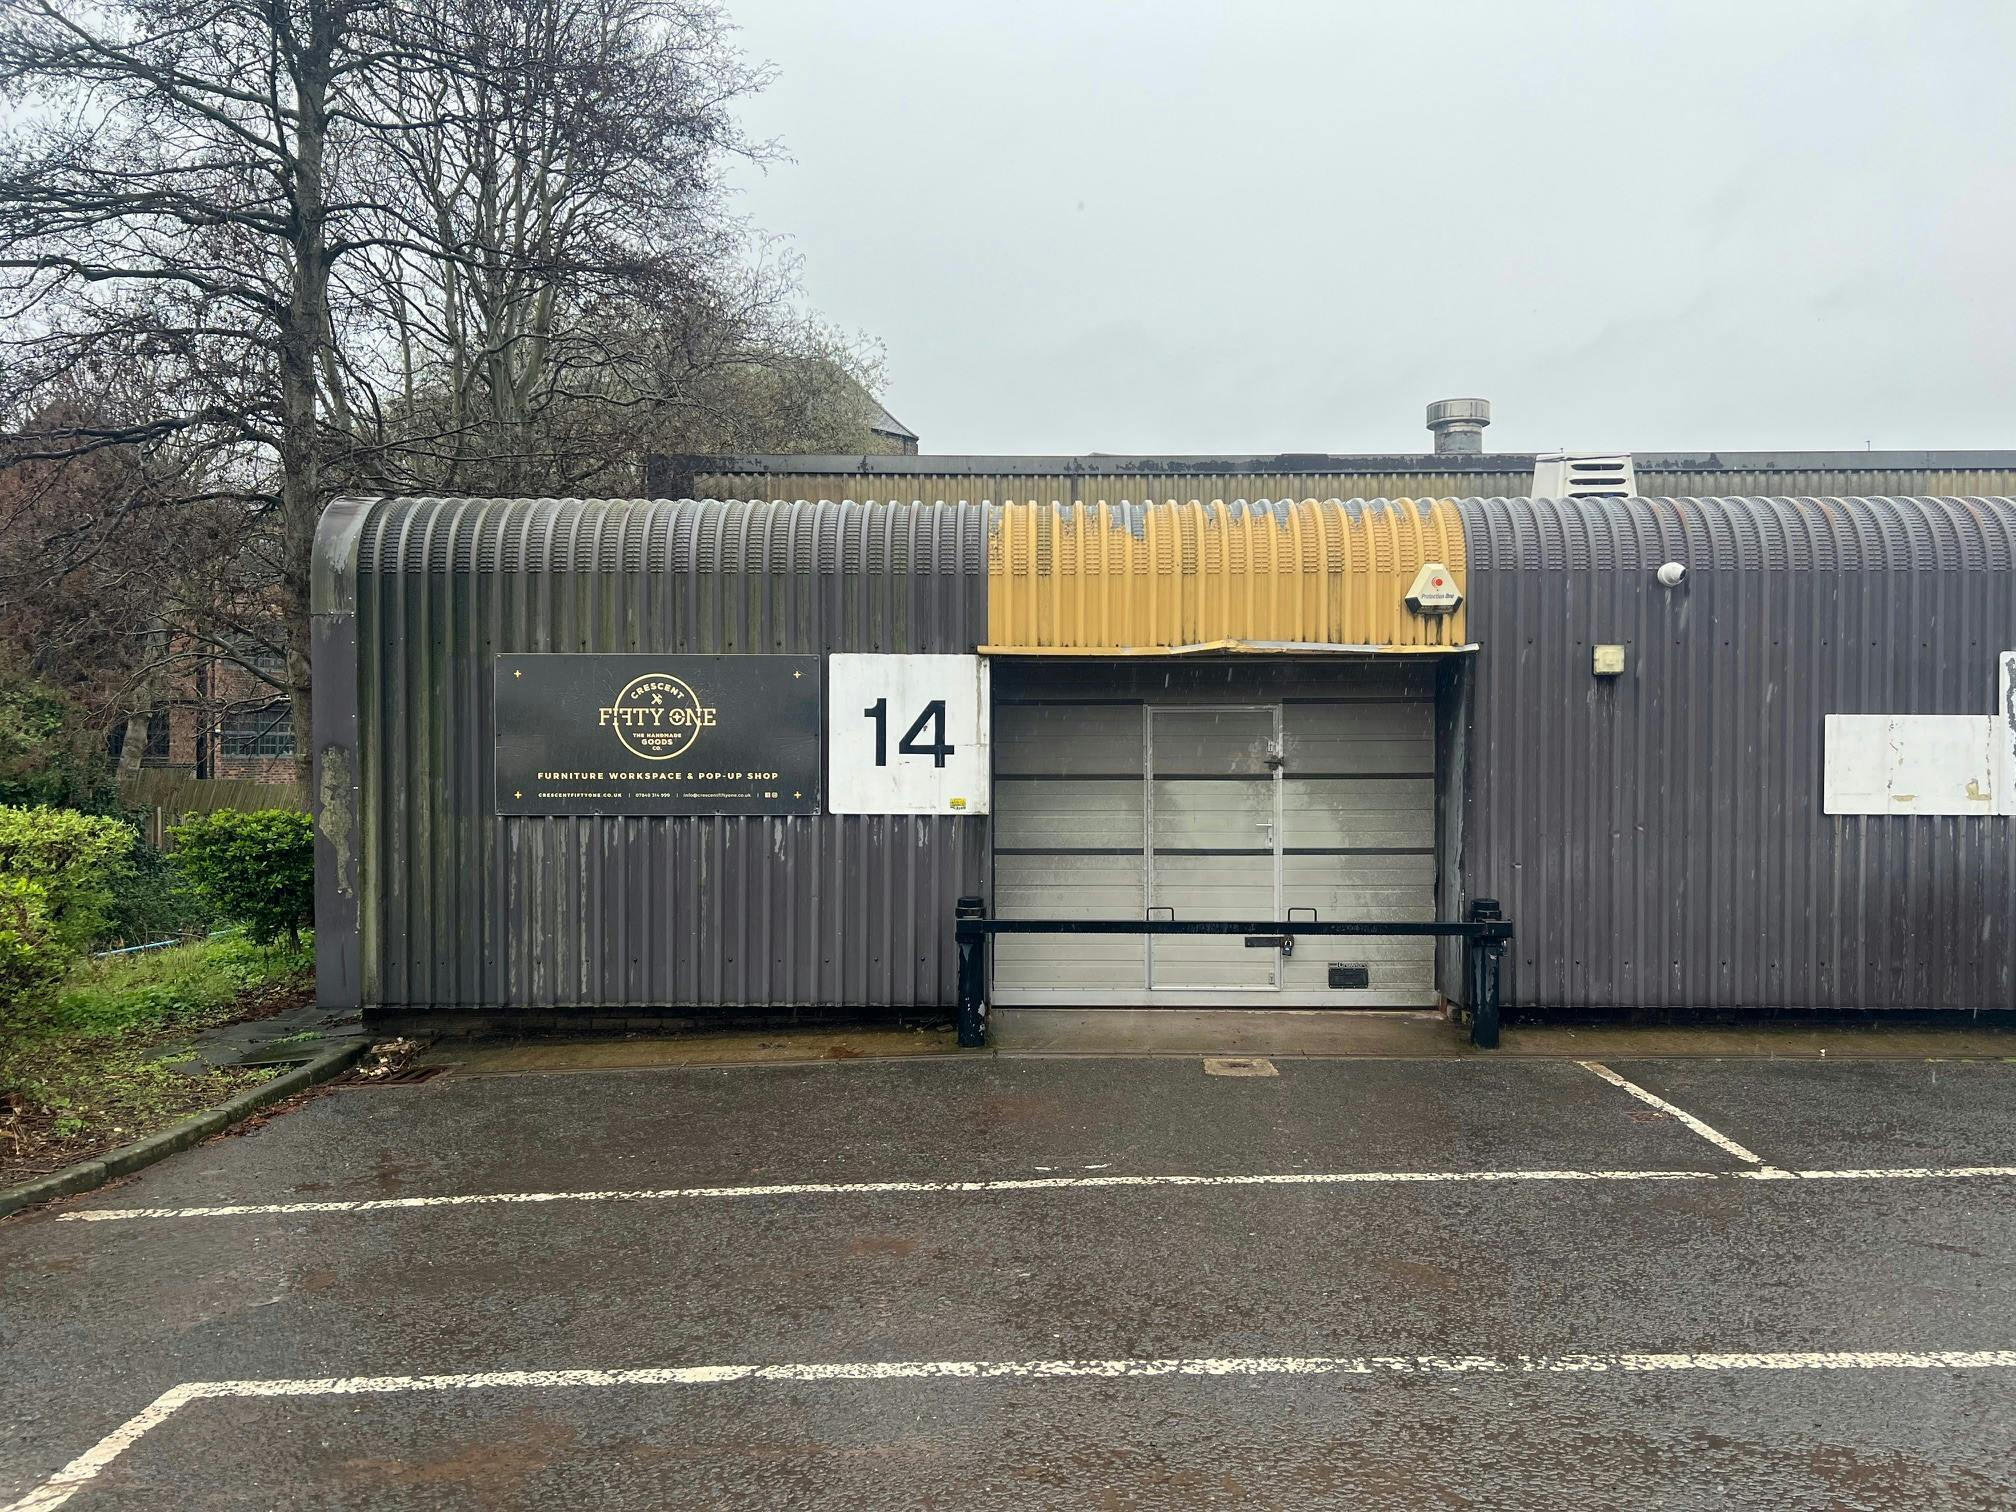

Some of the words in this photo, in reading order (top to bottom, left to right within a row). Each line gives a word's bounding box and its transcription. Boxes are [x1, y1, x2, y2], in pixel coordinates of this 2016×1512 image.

[630, 682, 685, 700] CRESCENT
[598, 707, 665, 726] FIFTY
[668, 707, 717, 726] ONE
[864, 697, 954, 768] 14
[641, 738, 673, 746] GOODS
[537, 772, 604, 780] FURNITURE
[608, 772, 682, 780] WORKSPACE
[686, 772, 694, 780] &
[698, 772, 743, 780] POP-UP
[746, 772, 779, 780] SHOP
